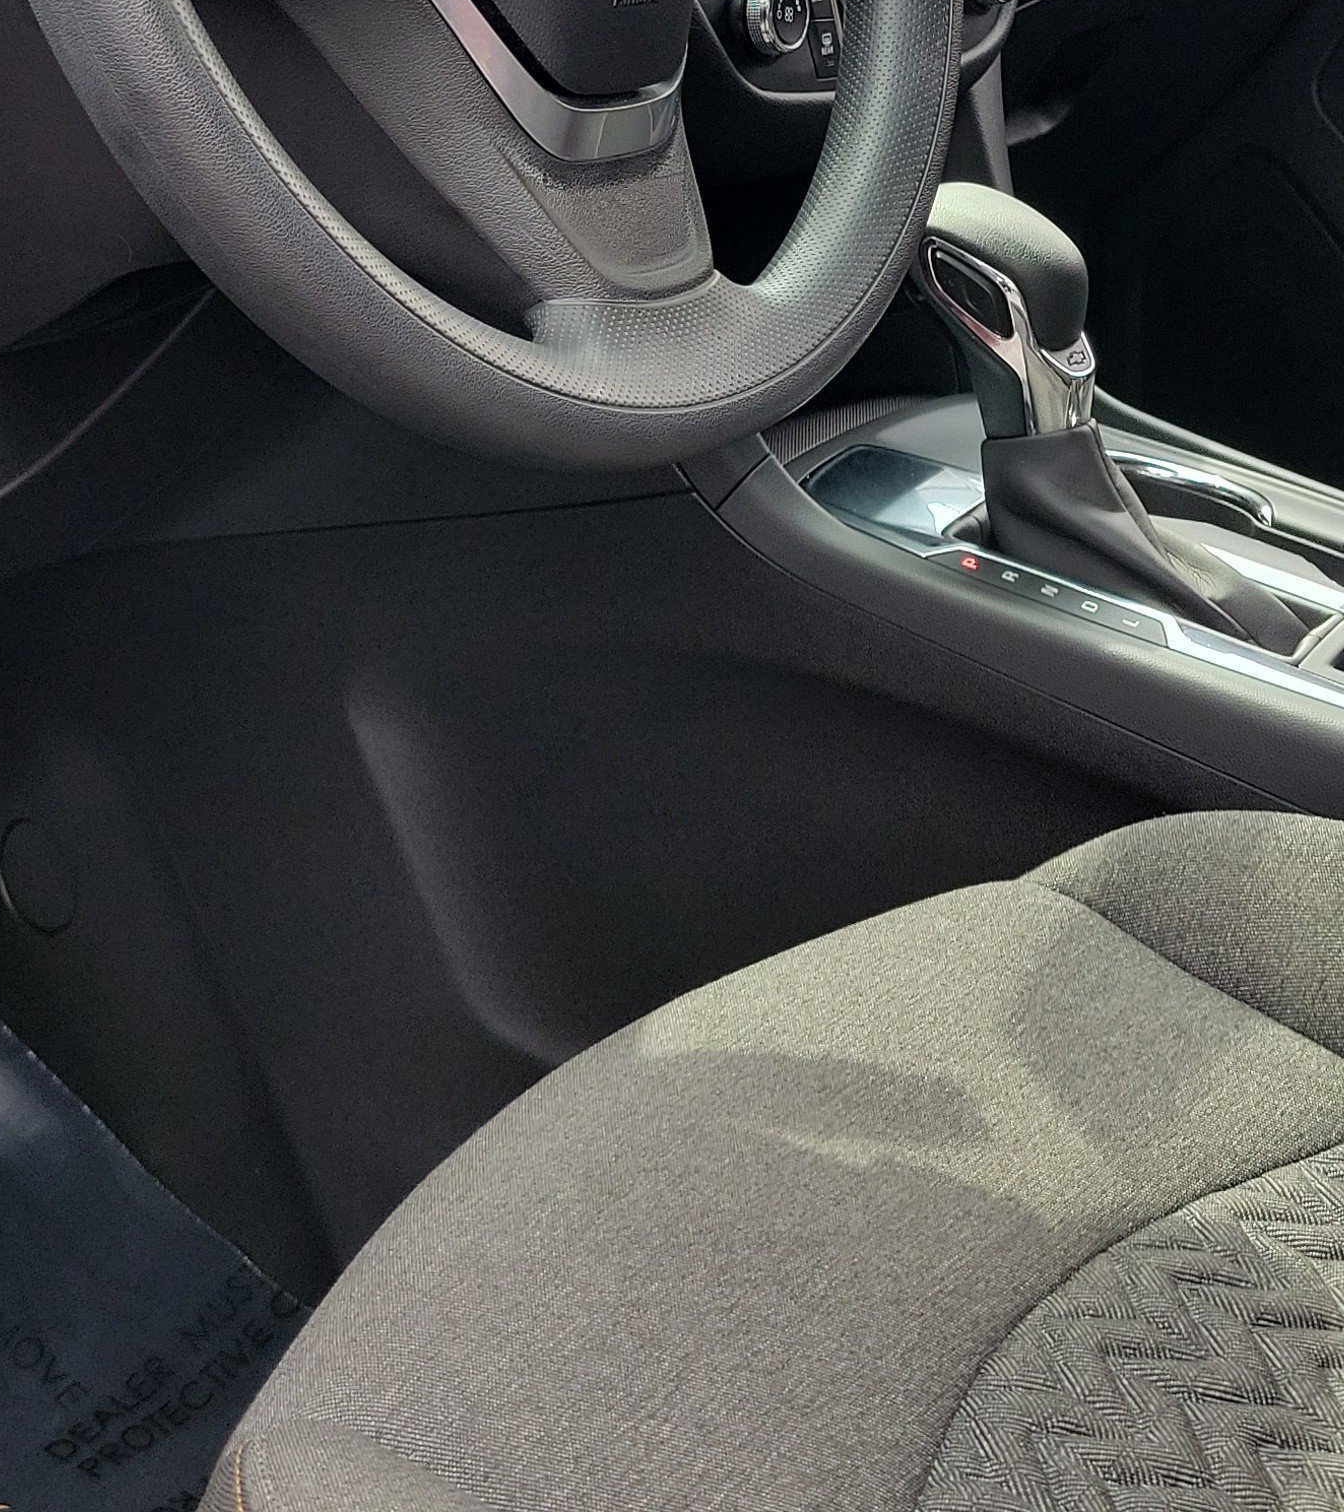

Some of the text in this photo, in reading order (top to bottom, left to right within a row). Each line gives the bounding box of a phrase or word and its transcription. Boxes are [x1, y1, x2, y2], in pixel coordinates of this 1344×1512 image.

[961, 556, 978, 571] P
[1001, 570, 1019, 584] R
[1122, 618, 1140, 629] L
[42, 1354, 178, 1463] DEALER
[77, 1318, 276, 1480] PROTECTIVE
